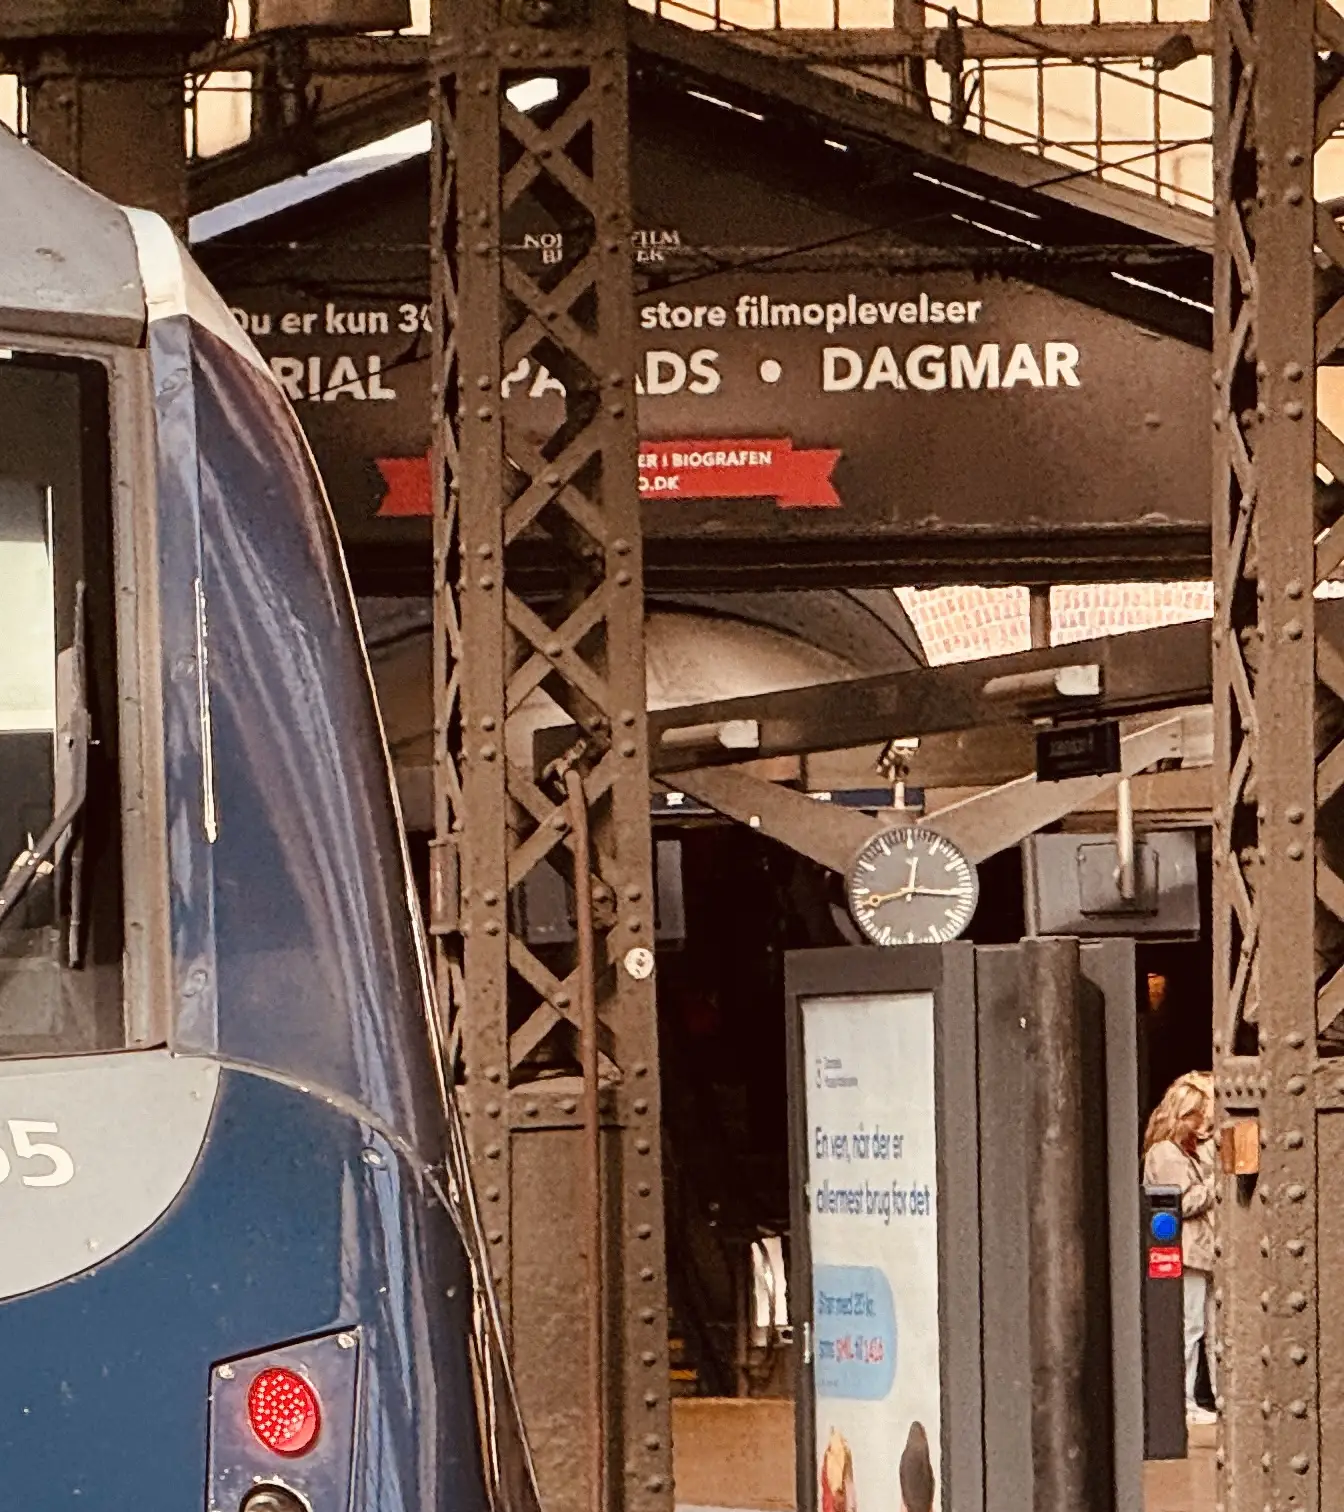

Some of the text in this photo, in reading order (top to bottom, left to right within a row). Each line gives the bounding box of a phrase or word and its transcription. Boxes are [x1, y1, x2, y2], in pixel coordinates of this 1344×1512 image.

[280, 312, 318, 335] er
[326, 302, 389, 335] kun
[640, 293, 983, 334] store filmoplevelser
[822, 342, 1081, 392] DAGMAR
[672, 450, 773, 468] BIOGRAFEN
